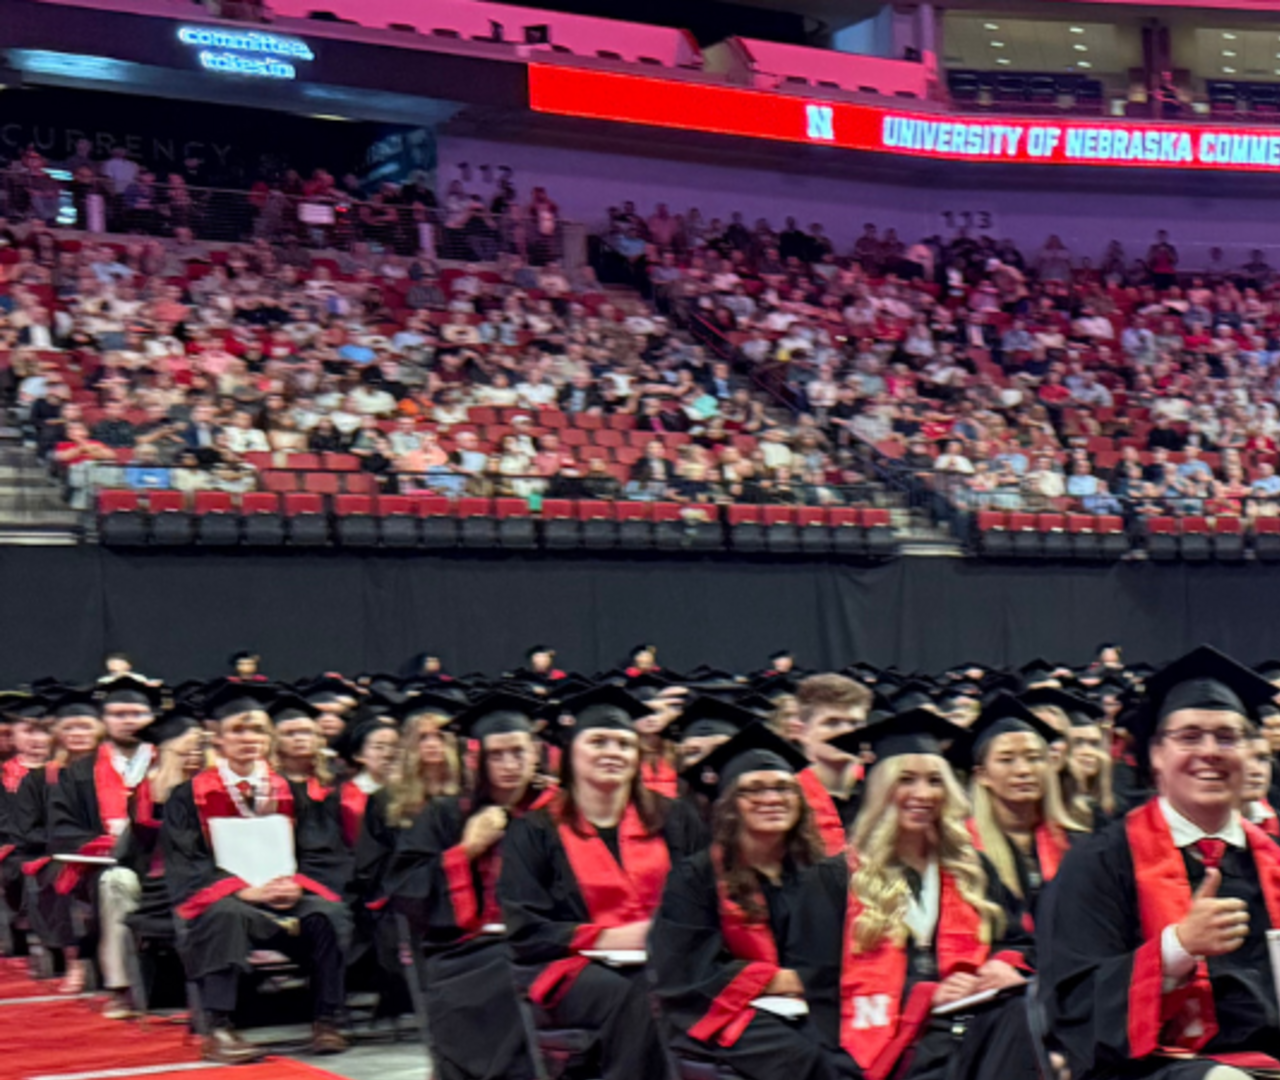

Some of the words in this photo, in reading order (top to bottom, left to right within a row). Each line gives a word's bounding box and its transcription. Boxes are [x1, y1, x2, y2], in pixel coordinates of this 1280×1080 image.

[806, 105, 834, 139] N
[883, 115, 1023, 156] UNIVERSITY
[1027, 127, 1062, 157] OF
[1064, 128, 1193, 162] NEBRASKA
[851, 993, 890, 1029] N
